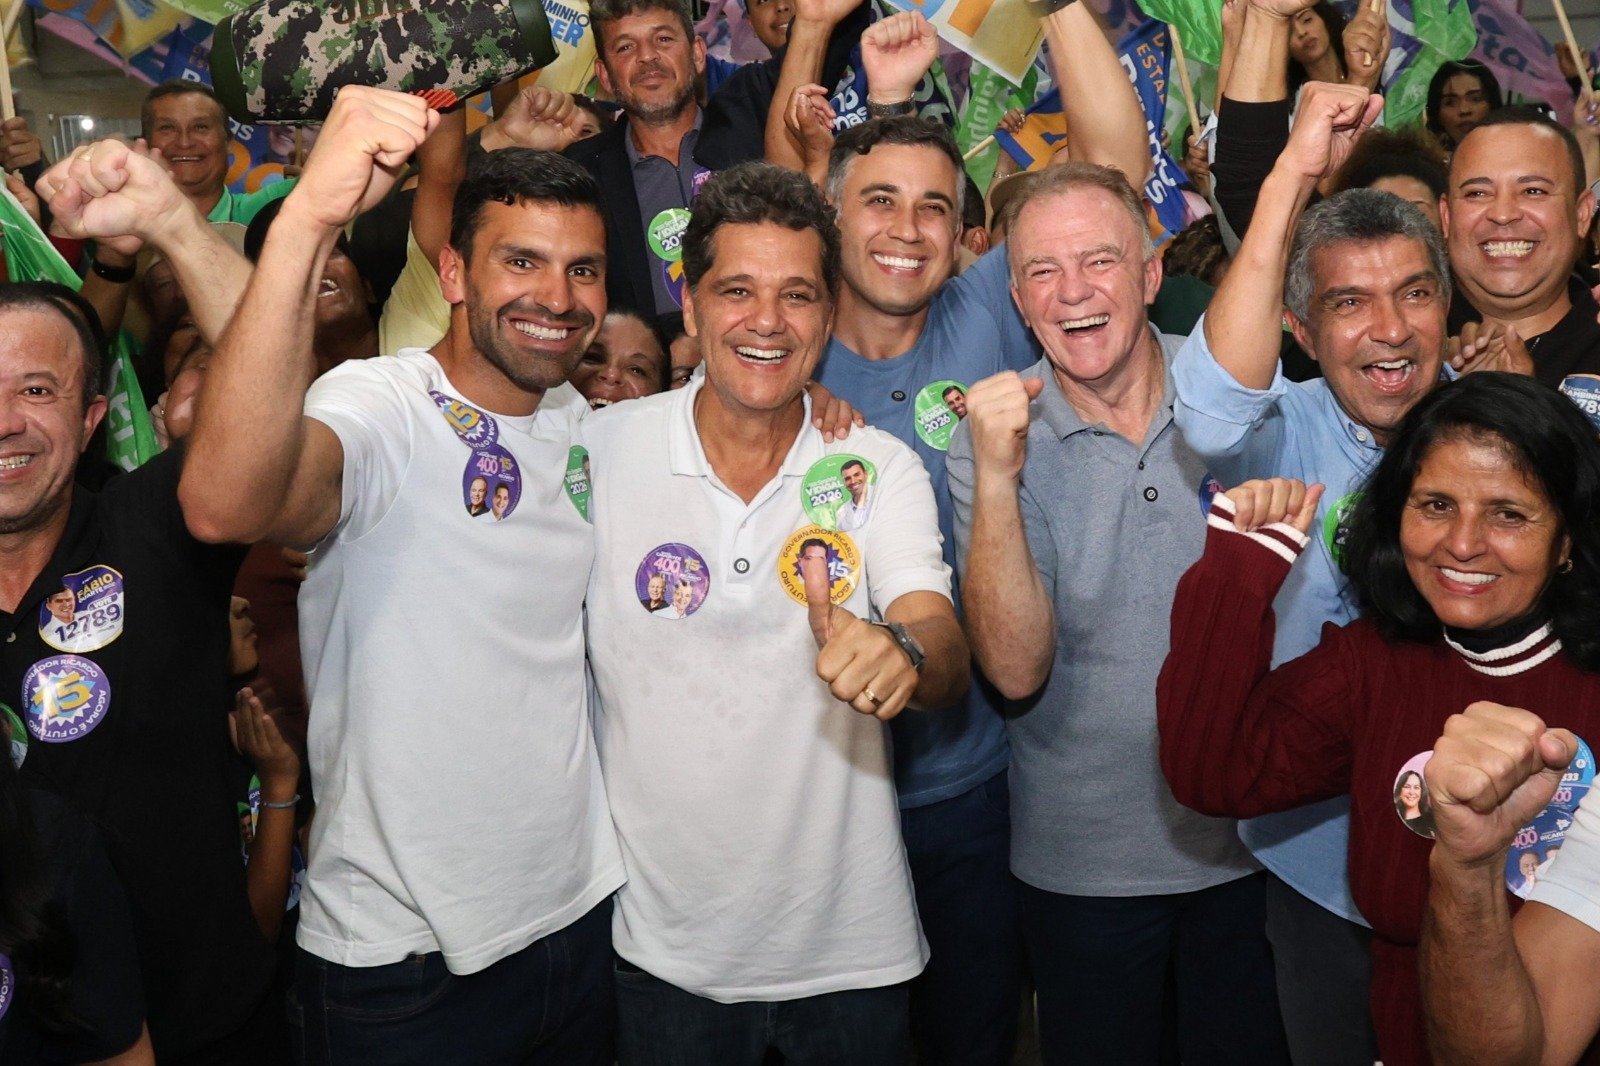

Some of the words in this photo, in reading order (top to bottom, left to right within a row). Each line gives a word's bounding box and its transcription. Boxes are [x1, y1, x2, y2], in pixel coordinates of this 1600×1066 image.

[541, 0, 590, 27] MINHO
[924, 414, 951, 434] 2026
[476, 457, 498, 475] 400
[805, 480, 844, 496] VIDIGAL
[810, 489, 843, 507] 2026
[782, 528, 833, 558] GOVERNADOR
[653, 557, 680, 574] 400
[828, 561, 848, 577] 15
[55, 603, 120, 642] 12789
[23, 659, 59, 709] GOVERNADOR
[60, 659, 98, 678] RICARDO
[85, 689, 107, 724] AGORA
[68, 727, 79, 735] O
